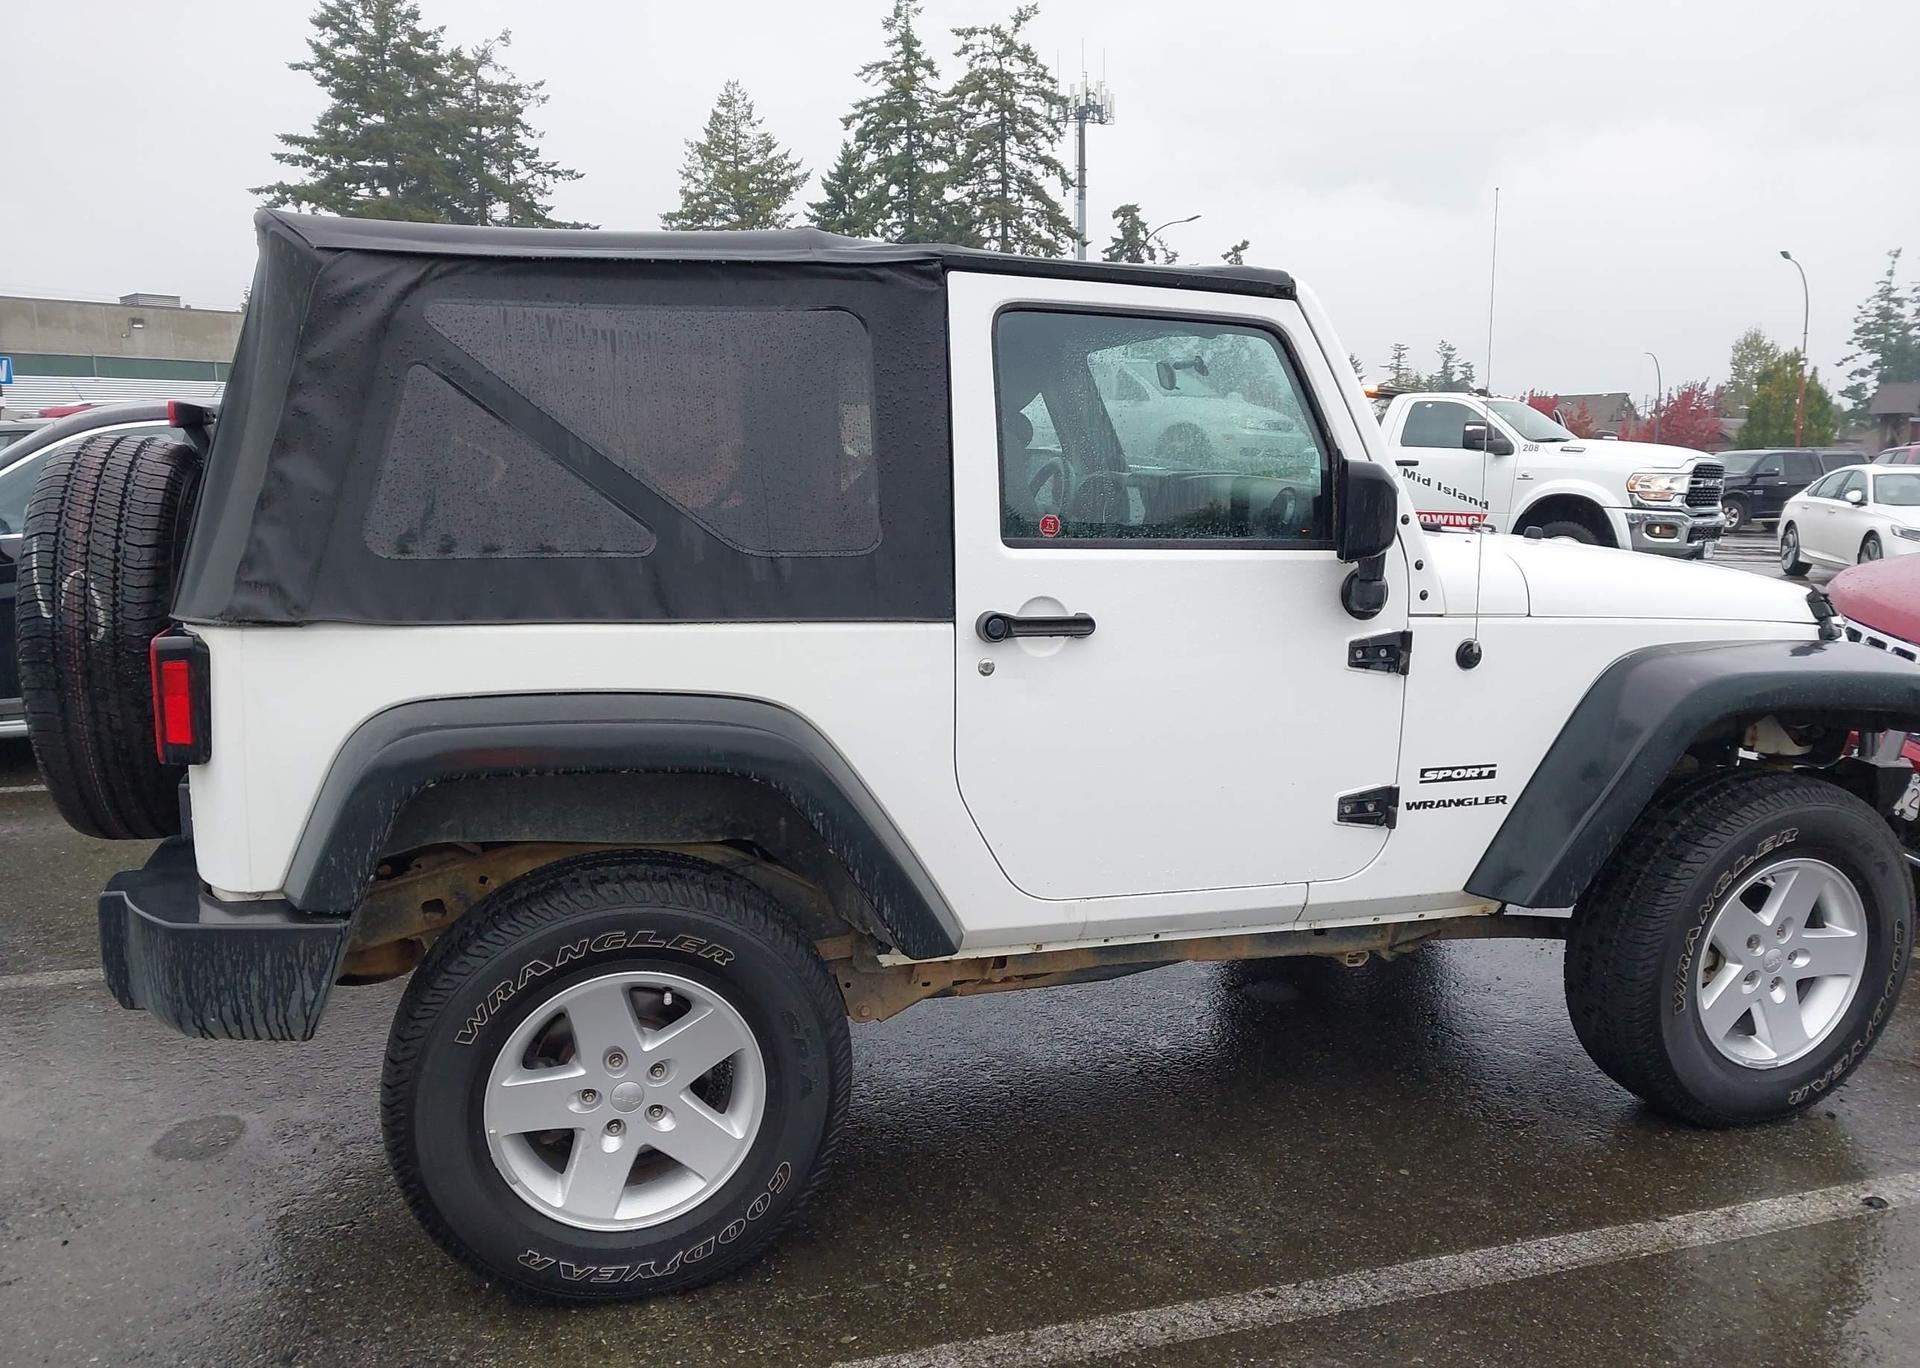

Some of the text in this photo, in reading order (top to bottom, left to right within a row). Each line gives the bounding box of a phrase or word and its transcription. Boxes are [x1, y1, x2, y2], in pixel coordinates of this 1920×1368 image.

[1402, 467, 1489, 510] Mid Island
[1417, 513, 1480, 526] OWING
[1422, 766, 1497, 781] SPORT
[1405, 795, 1508, 811] WRANGLER
[1674, 827, 1799, 1016] WRANGLER
[454, 930, 736, 1046] WRANGLER
[516, 1160, 793, 1284] GOODYEAR
